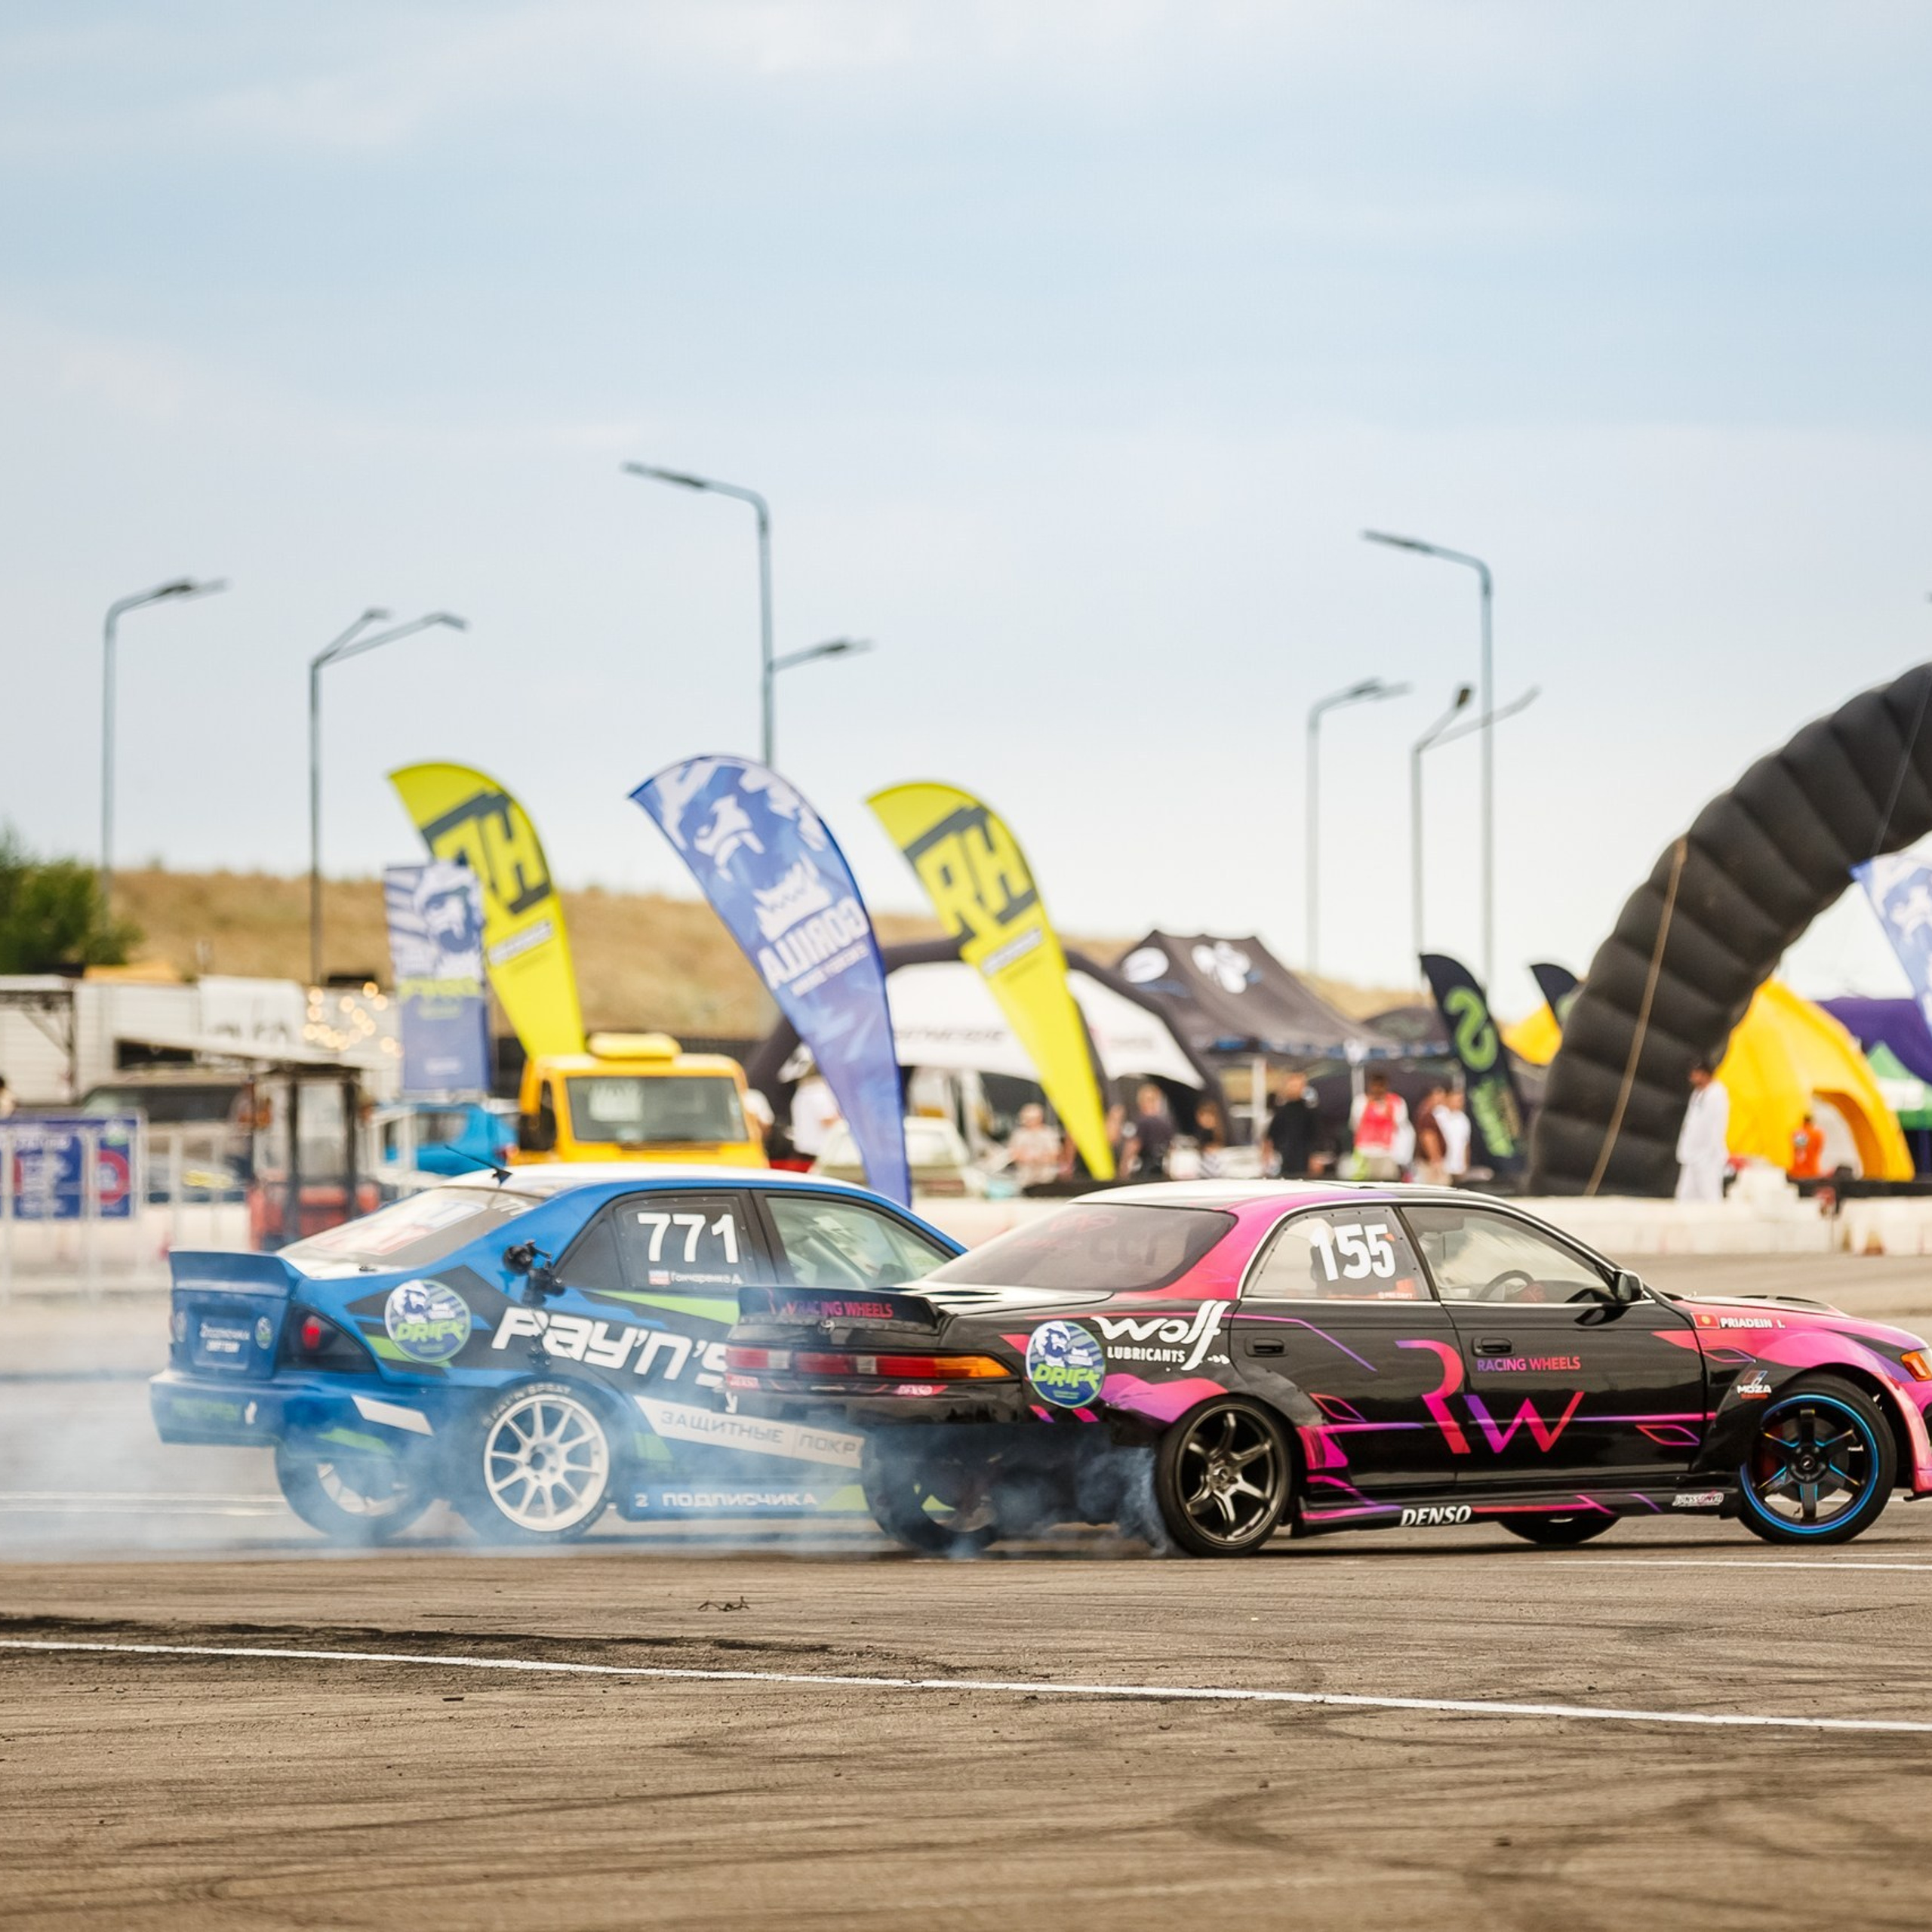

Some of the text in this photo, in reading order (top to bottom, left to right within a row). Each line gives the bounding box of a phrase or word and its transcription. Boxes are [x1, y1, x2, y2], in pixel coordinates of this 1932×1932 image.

[637, 1211, 739, 1263] 771
[1310, 1223, 1396, 1281] 155
[843, 1303, 894, 1318] WHEELS
[395, 1321, 466, 1343] DRIFT
[1720, 1317, 1773, 1328] PRIADEIN
[1106, 1346, 1186, 1363] LUBRICANTS
[1477, 1356, 1581, 1372] RACING WHEELS
[1033, 1363, 1100, 1390] DRIFT
[1395, 1339, 1585, 1454] RW
[1737, 1384, 1772, 1394] MOZA
[660, 1411, 785, 1444] ЗАЩИТНЫЕ
[634, 1491, 818, 1508] 2 ПОДПИСЧИКА
[1400, 1505, 1472, 1527] DENSO
